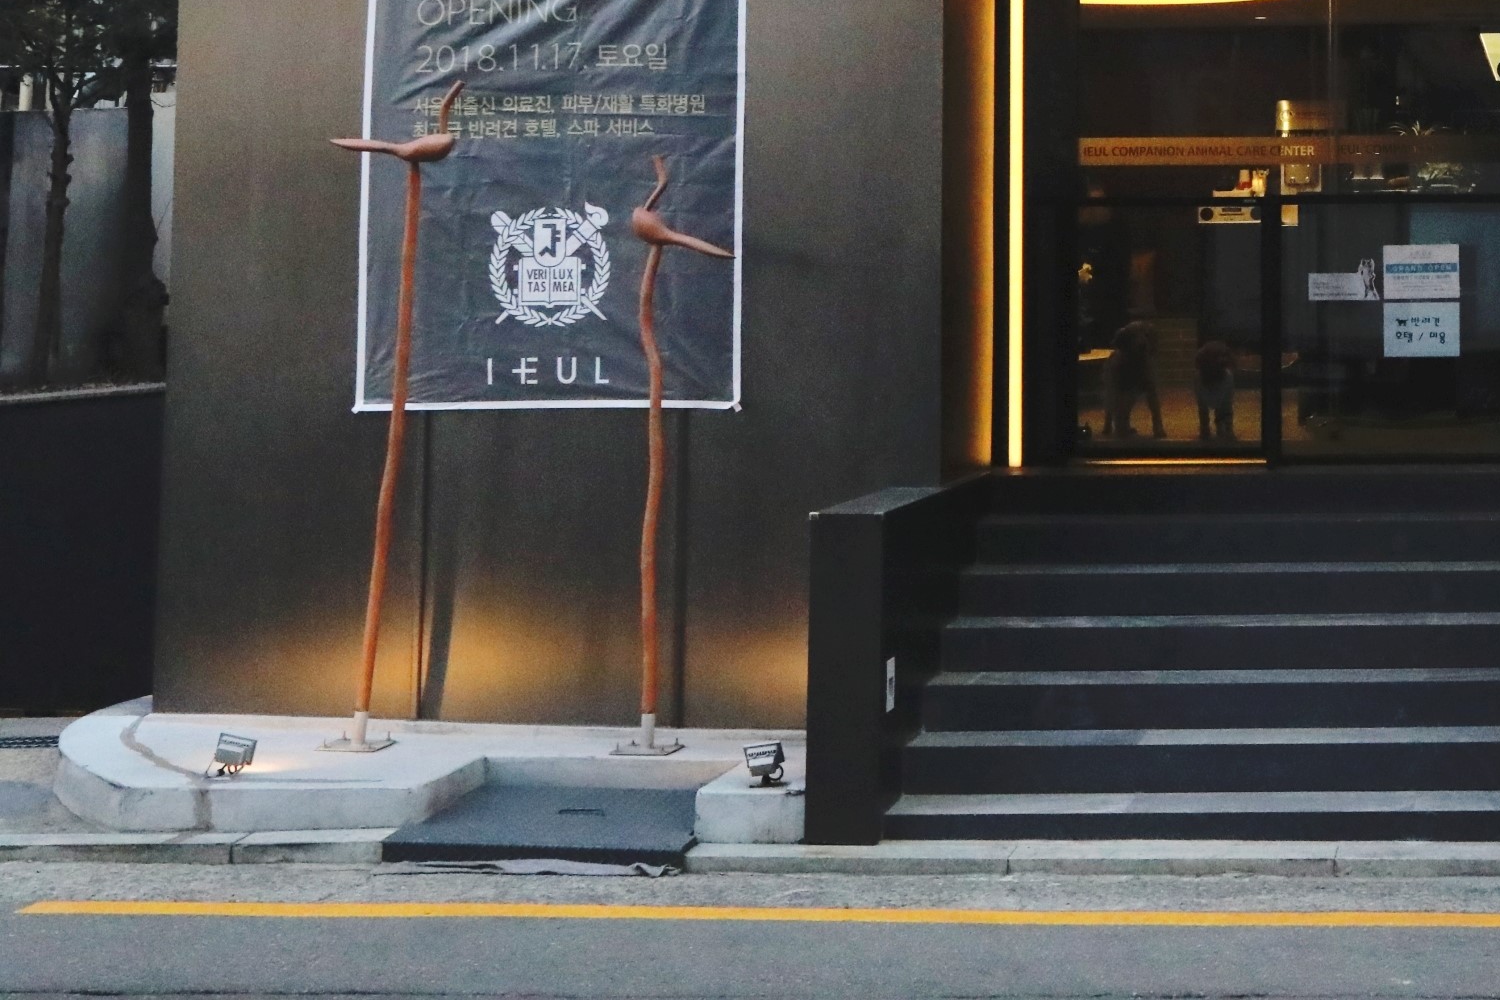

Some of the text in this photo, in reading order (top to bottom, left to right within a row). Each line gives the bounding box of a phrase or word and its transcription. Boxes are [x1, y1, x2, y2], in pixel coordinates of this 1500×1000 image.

[415, 42, 668, 73] 2018.11.17. 토요일
[502, 95, 555, 115] 의료진,
[562, 94, 634, 115] 피부/재활
[639, 94, 706, 115] 특화병원
[468, 119, 518, 139] 반려견
[525, 119, 560, 138] 호텔,
[567, 118, 600, 137] 스파
[606, 118, 655, 137] 서비스
[1083, 145, 1315, 157] IEUL COMPANION ANIMAL CARE CENTER
[527, 269, 573, 280] VERI LUX
[528, 282, 574, 293] TAS MEA
[487, 357, 610, 385] IEUL
